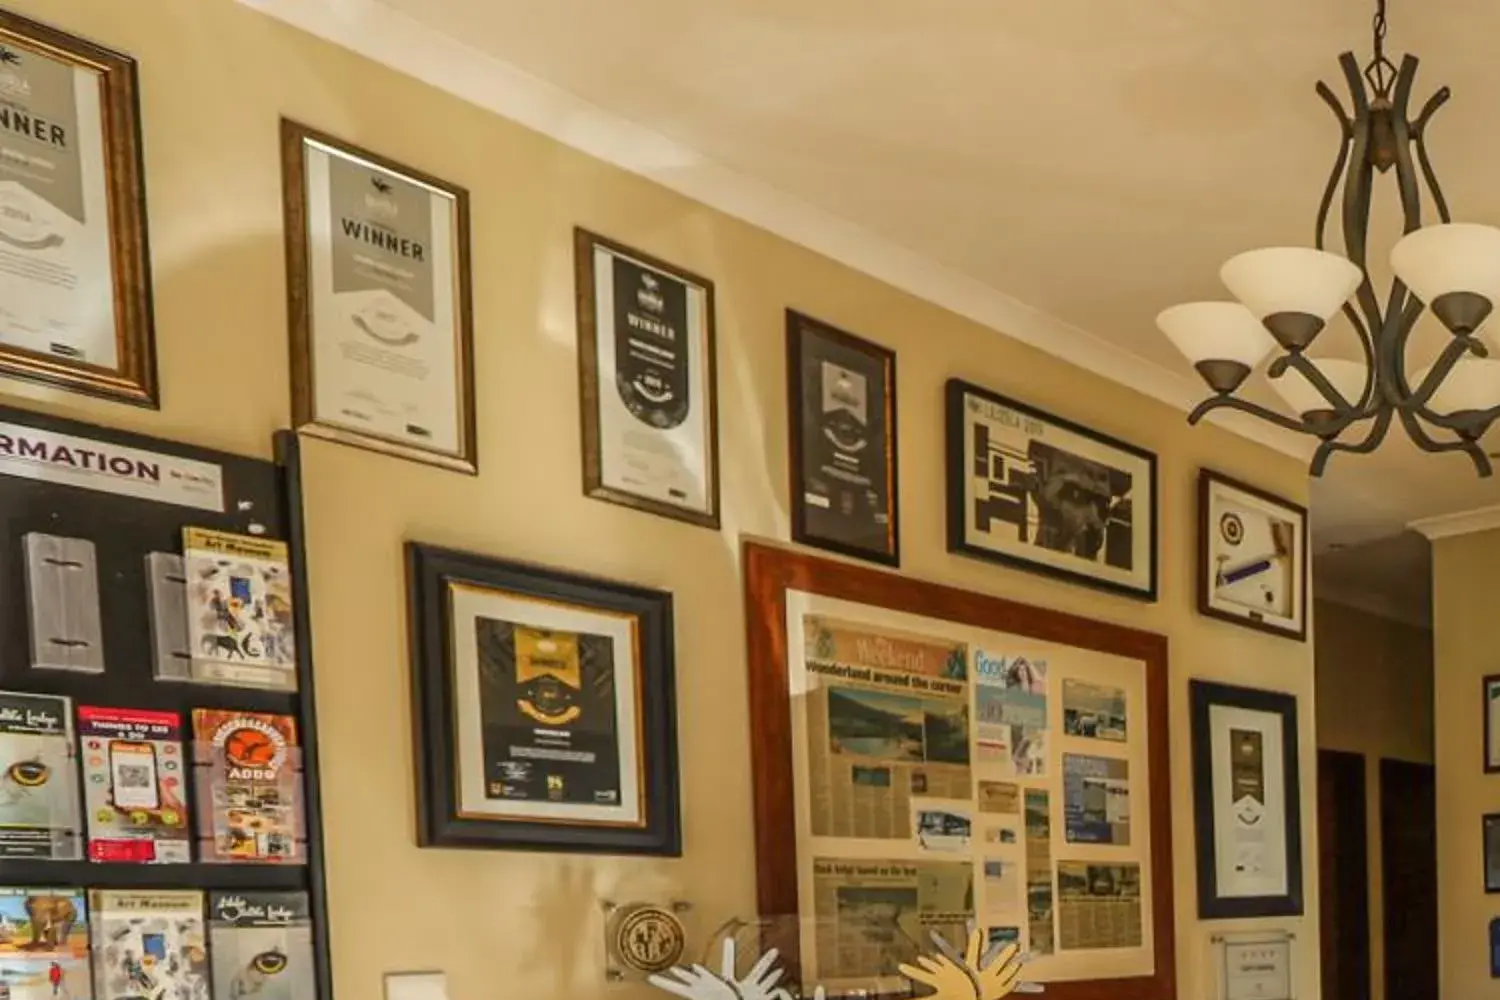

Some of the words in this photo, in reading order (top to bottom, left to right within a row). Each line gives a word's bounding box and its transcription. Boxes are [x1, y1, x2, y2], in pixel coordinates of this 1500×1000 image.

[0, 108, 66, 147] NNER
[341, 217, 425, 262] WINNER
[0, 434, 160, 482] RMATION
[228, 767, 275, 780] ADDO
